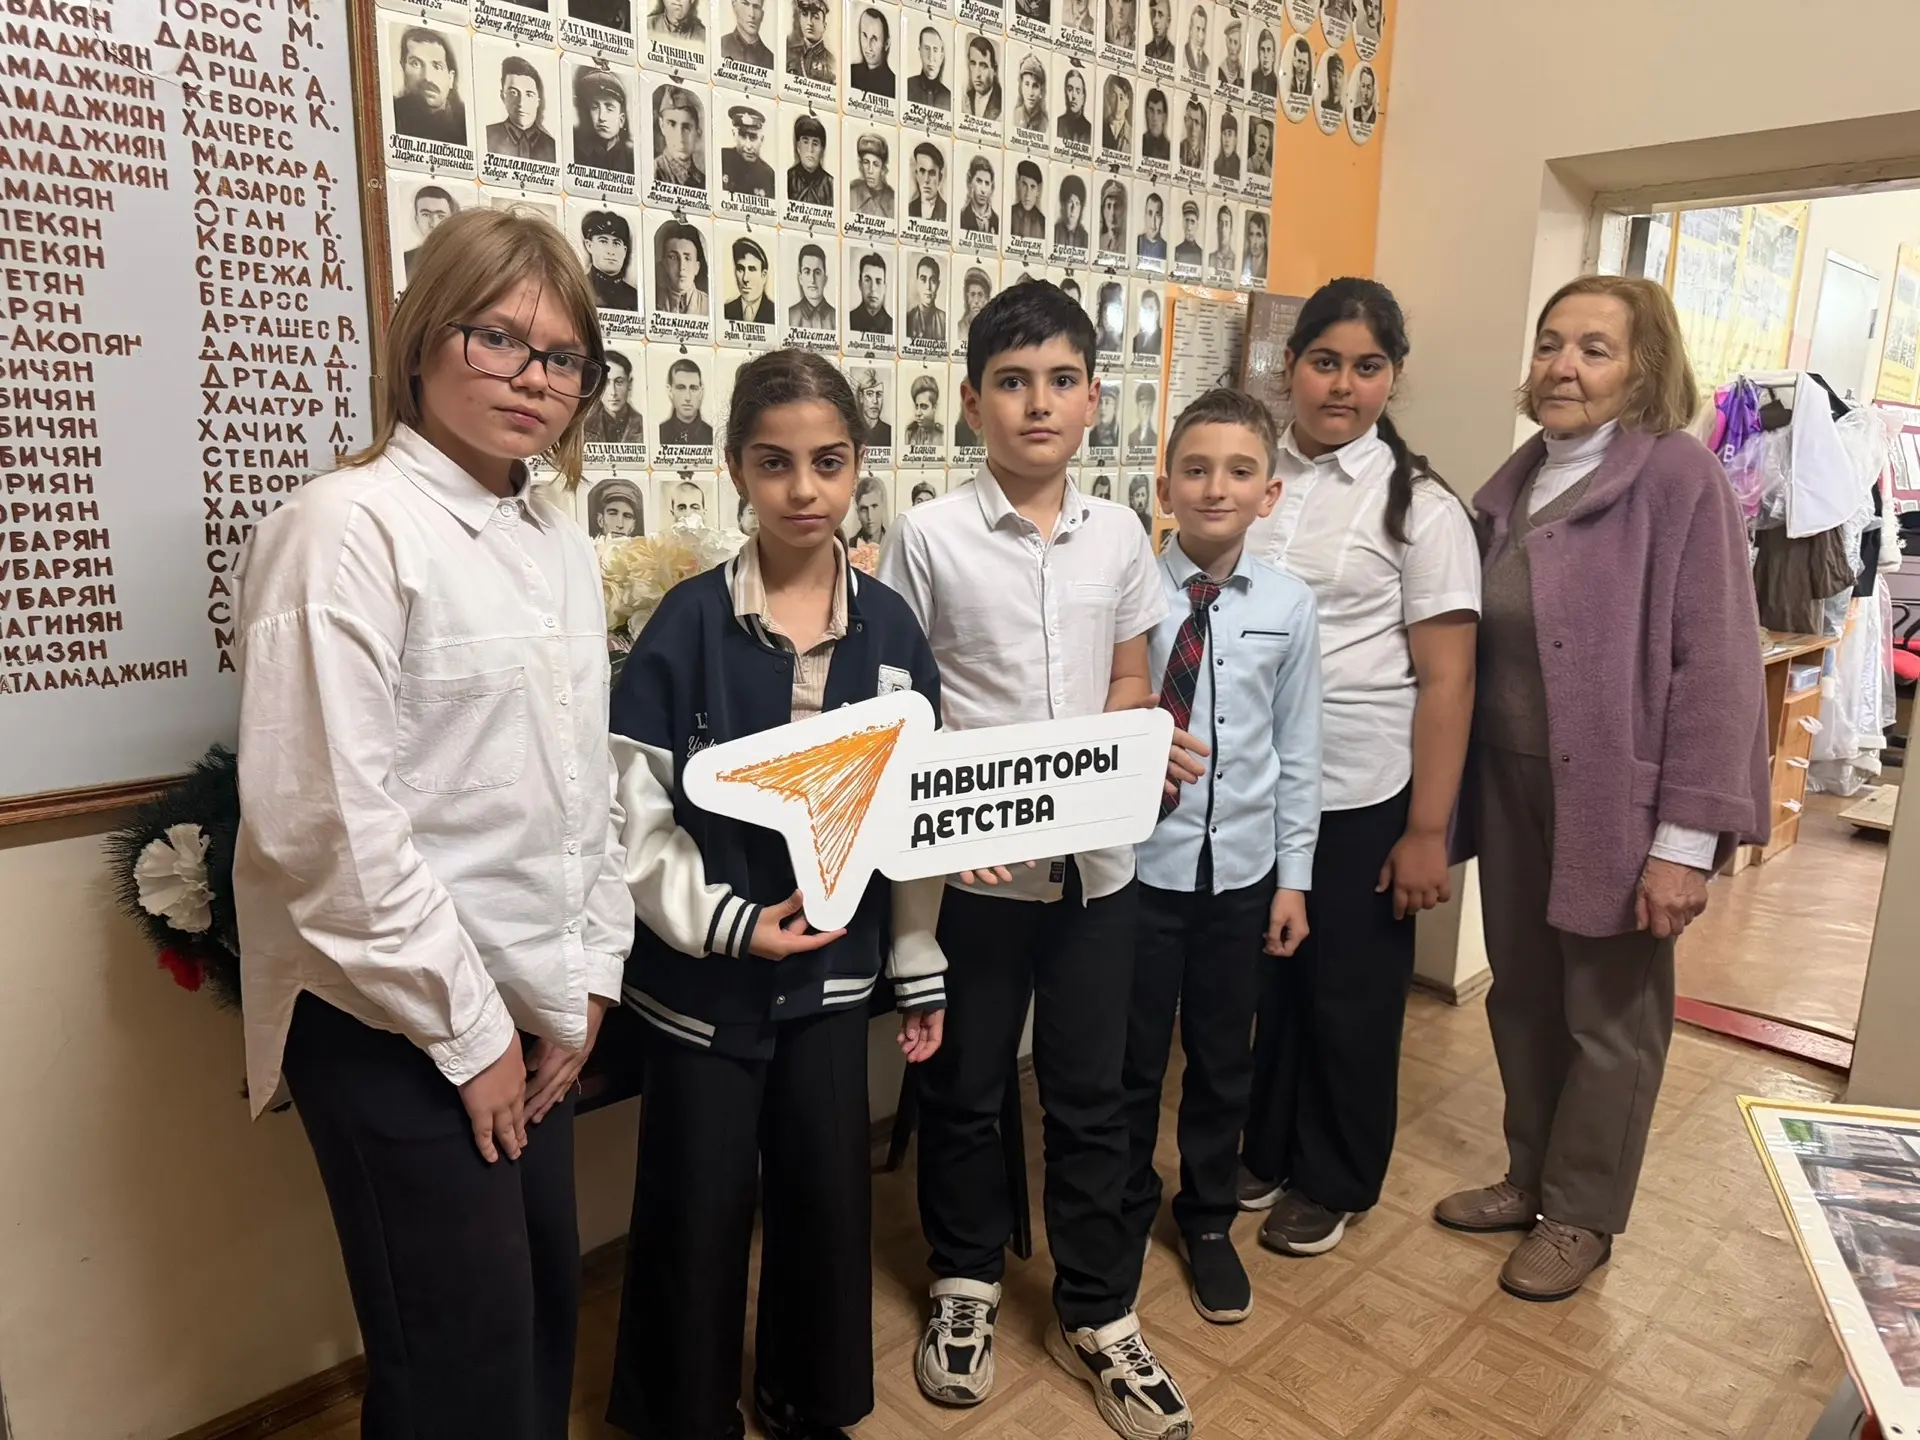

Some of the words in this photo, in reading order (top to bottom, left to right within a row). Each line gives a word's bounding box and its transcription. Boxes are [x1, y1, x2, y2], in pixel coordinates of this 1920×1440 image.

[0, 0, 113, 33] ВАКЯН
[288, 17, 324, 49] М.
[0, 21, 152, 71] МАДЖИЯН
[154, 21, 257, 63] ДАВИД
[282, 43, 310, 73] В.
[175, 53, 296, 98] АРШАК
[305, 75, 336, 106] А.
[181, 82, 298, 125] КЕВОРК
[309, 103, 340, 133] К.
[182, 108, 294, 151] ХАЧЕРЕС
[191, 140, 308, 179] МАРКАР
[313, 160, 338, 184] А.
[0, 177, 115, 212] МАНЯН
[193, 169, 306, 207] ХАЗАРОС
[317, 184, 337, 212] Т.
[194, 198, 285, 231] ОГАН
[315, 212, 342, 240] К.
[196, 225, 309, 260] КЕВОРК
[323, 238, 346, 265] В.
[0, 268, 85, 296] ЕТЯН
[195, 255, 312, 287] СЕРЕЖА
[321, 263, 353, 291] М.
[200, 282, 309, 312] БЕДРОС
[201, 310, 330, 340] АРТАШЕС
[198, 335, 318, 366] ДАНИЕЛ
[327, 370, 352, 393] Н.
[202, 390, 323, 417] ХАЧАТУР
[335, 396, 357, 418] Н.
[198, 418, 307, 444] ХАЧИК
[0, 446, 102, 468] БИЧЯН
[202, 446, 309, 468] СТЕПАН
[0, 473, 94, 494] РИЯН
[0, 610, 123, 640] АГИНЯН
[0, 639, 108, 667] КИЗЯН
[911, 744, 1118, 801] НАВИГАТОРЫ
[911, 794, 1055, 848] ДЕТСТВА
